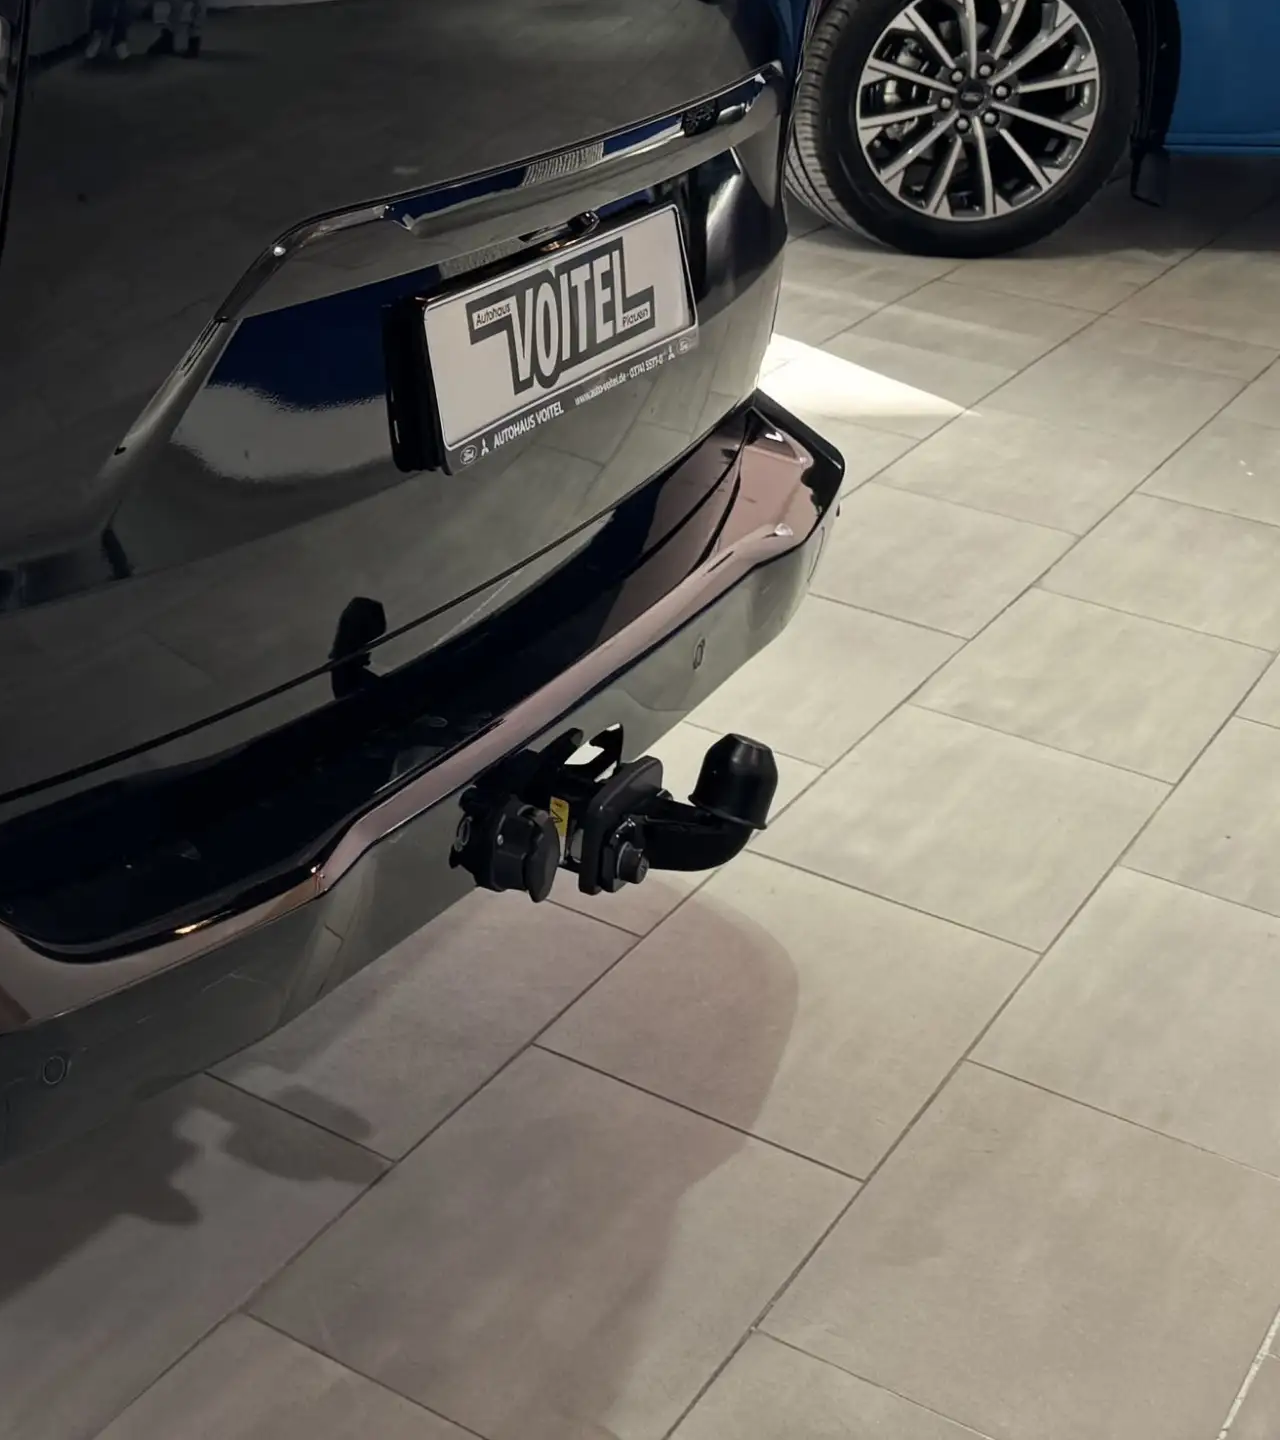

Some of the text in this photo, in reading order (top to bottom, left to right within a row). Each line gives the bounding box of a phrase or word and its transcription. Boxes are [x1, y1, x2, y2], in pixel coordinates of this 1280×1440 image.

[475, 302, 512, 328] Autohaus
[507, 249, 623, 383] VOITEL
[493, 413, 536, 449] AUTOHAUS
[535, 400, 565, 425] VOITEL
